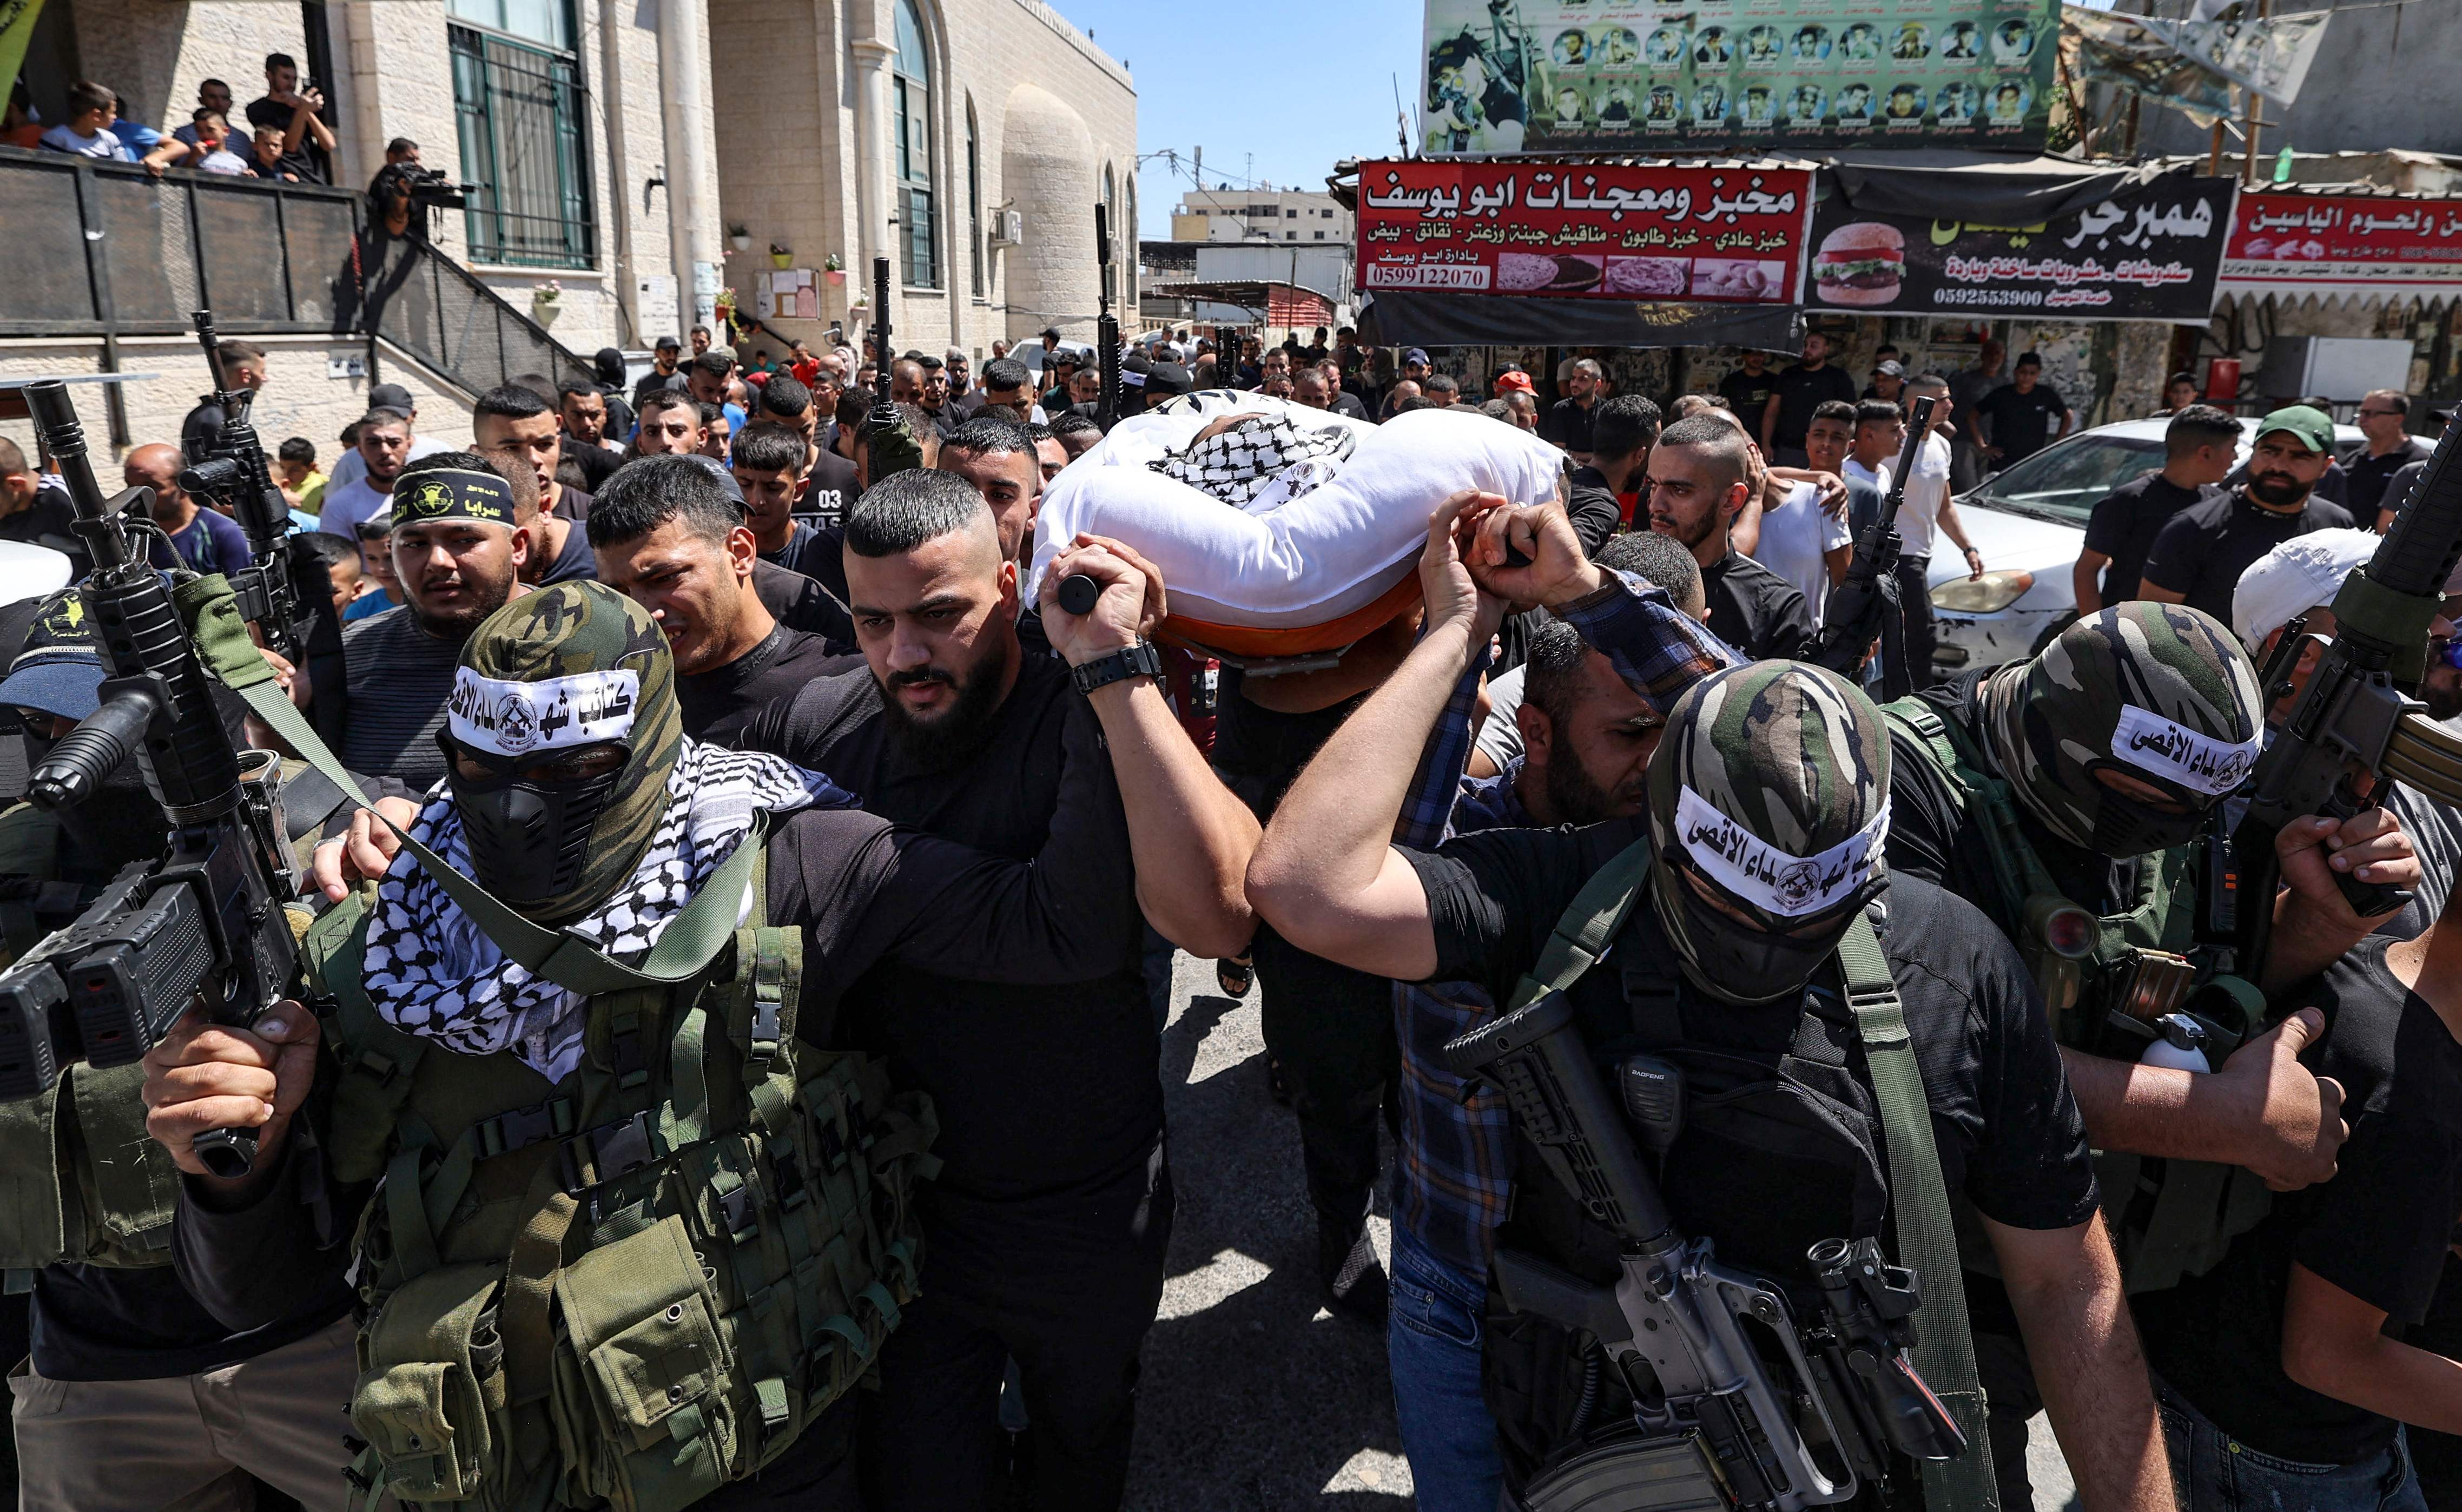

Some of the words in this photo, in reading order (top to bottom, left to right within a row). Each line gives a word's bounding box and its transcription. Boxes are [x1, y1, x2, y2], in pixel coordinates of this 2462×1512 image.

[1367, 171, 1461, 219] يوسف
[1462, 174, 1515, 218] ابو
[1524, 172, 1692, 221] ومعجنات
[1694, 176, 1796, 223] مخبز
[2062, 197, 2213, 250] همبرجر
[2248, 204, 2344, 234] الياسين
[2348, 208, 2434, 237] ولحوم
[1367, 221, 1401, 242] بيض
[1415, 221, 1451, 242] نقانق
[1463, 222, 1506, 243] وزعتر
[1509, 223, 1549, 246] جبنة
[1552, 223, 1607, 246] مناقيش
[1622, 226, 1667, 247] طابون
[1669, 225, 1699, 249] خبز
[1714, 228, 1759, 251] عادي
[1755, 229, 1787, 251] خبز
[1378, 249, 1416, 265] يوسف
[1421, 249, 1443, 263] ابو
[1445, 248, 1479, 264] بادارة
[1373, 268, 1483, 287] 0599122070
[1990, 256, 2039, 280] ساخنة
[1933, 288, 2043, 306] 0592553900
[464, 499, 501, 517] سرايا
[818, 490, 841, 509] 03
[578, 682, 631, 736] كتائب
[1632, 1069, 1666, 1080] BAOFENG
